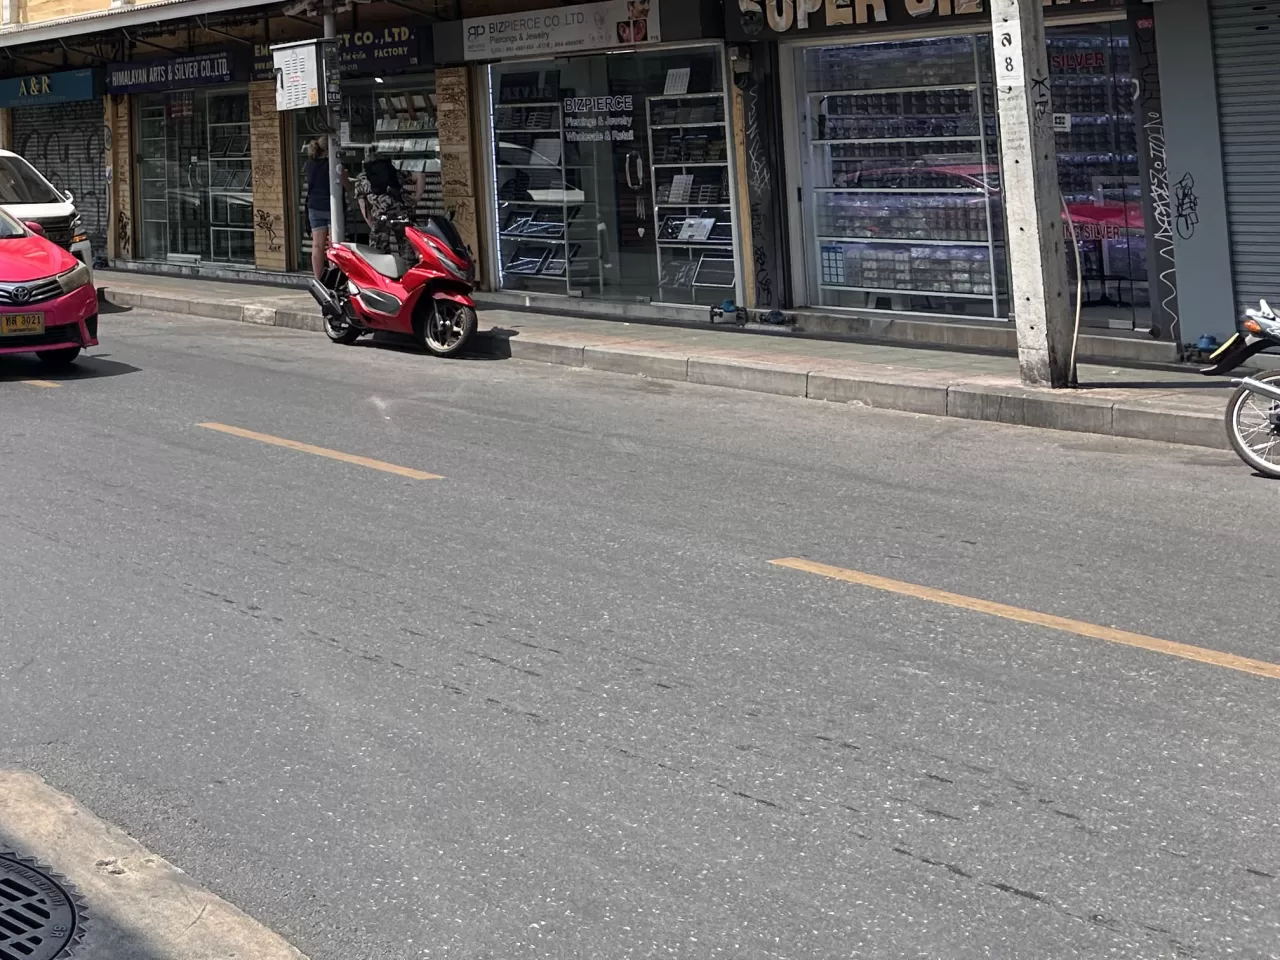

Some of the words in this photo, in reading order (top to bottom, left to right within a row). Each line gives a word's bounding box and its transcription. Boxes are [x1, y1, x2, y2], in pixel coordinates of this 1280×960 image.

[488, 17, 541, 34] BIZPIERCE
[489, 34, 518, 46] Piercings
[518, 33, 524, 41] &
[525, 31, 550, 42] Jewelry
[374, 47, 408, 58] FACTORY
[1051, 52, 1105, 69] SILVER
[1005, 56, 1014, 72] 8
[112, 67, 148, 86] HIMALAYAN
[149, 66, 166, 82] ARTS
[167, 65, 173, 80] &
[175, 62, 198, 80] SILVER
[564, 95, 633, 113] BIZPIERCE
[1084, 224, 1120, 240] SILVER
[21, 315, 41, 325] 3021
